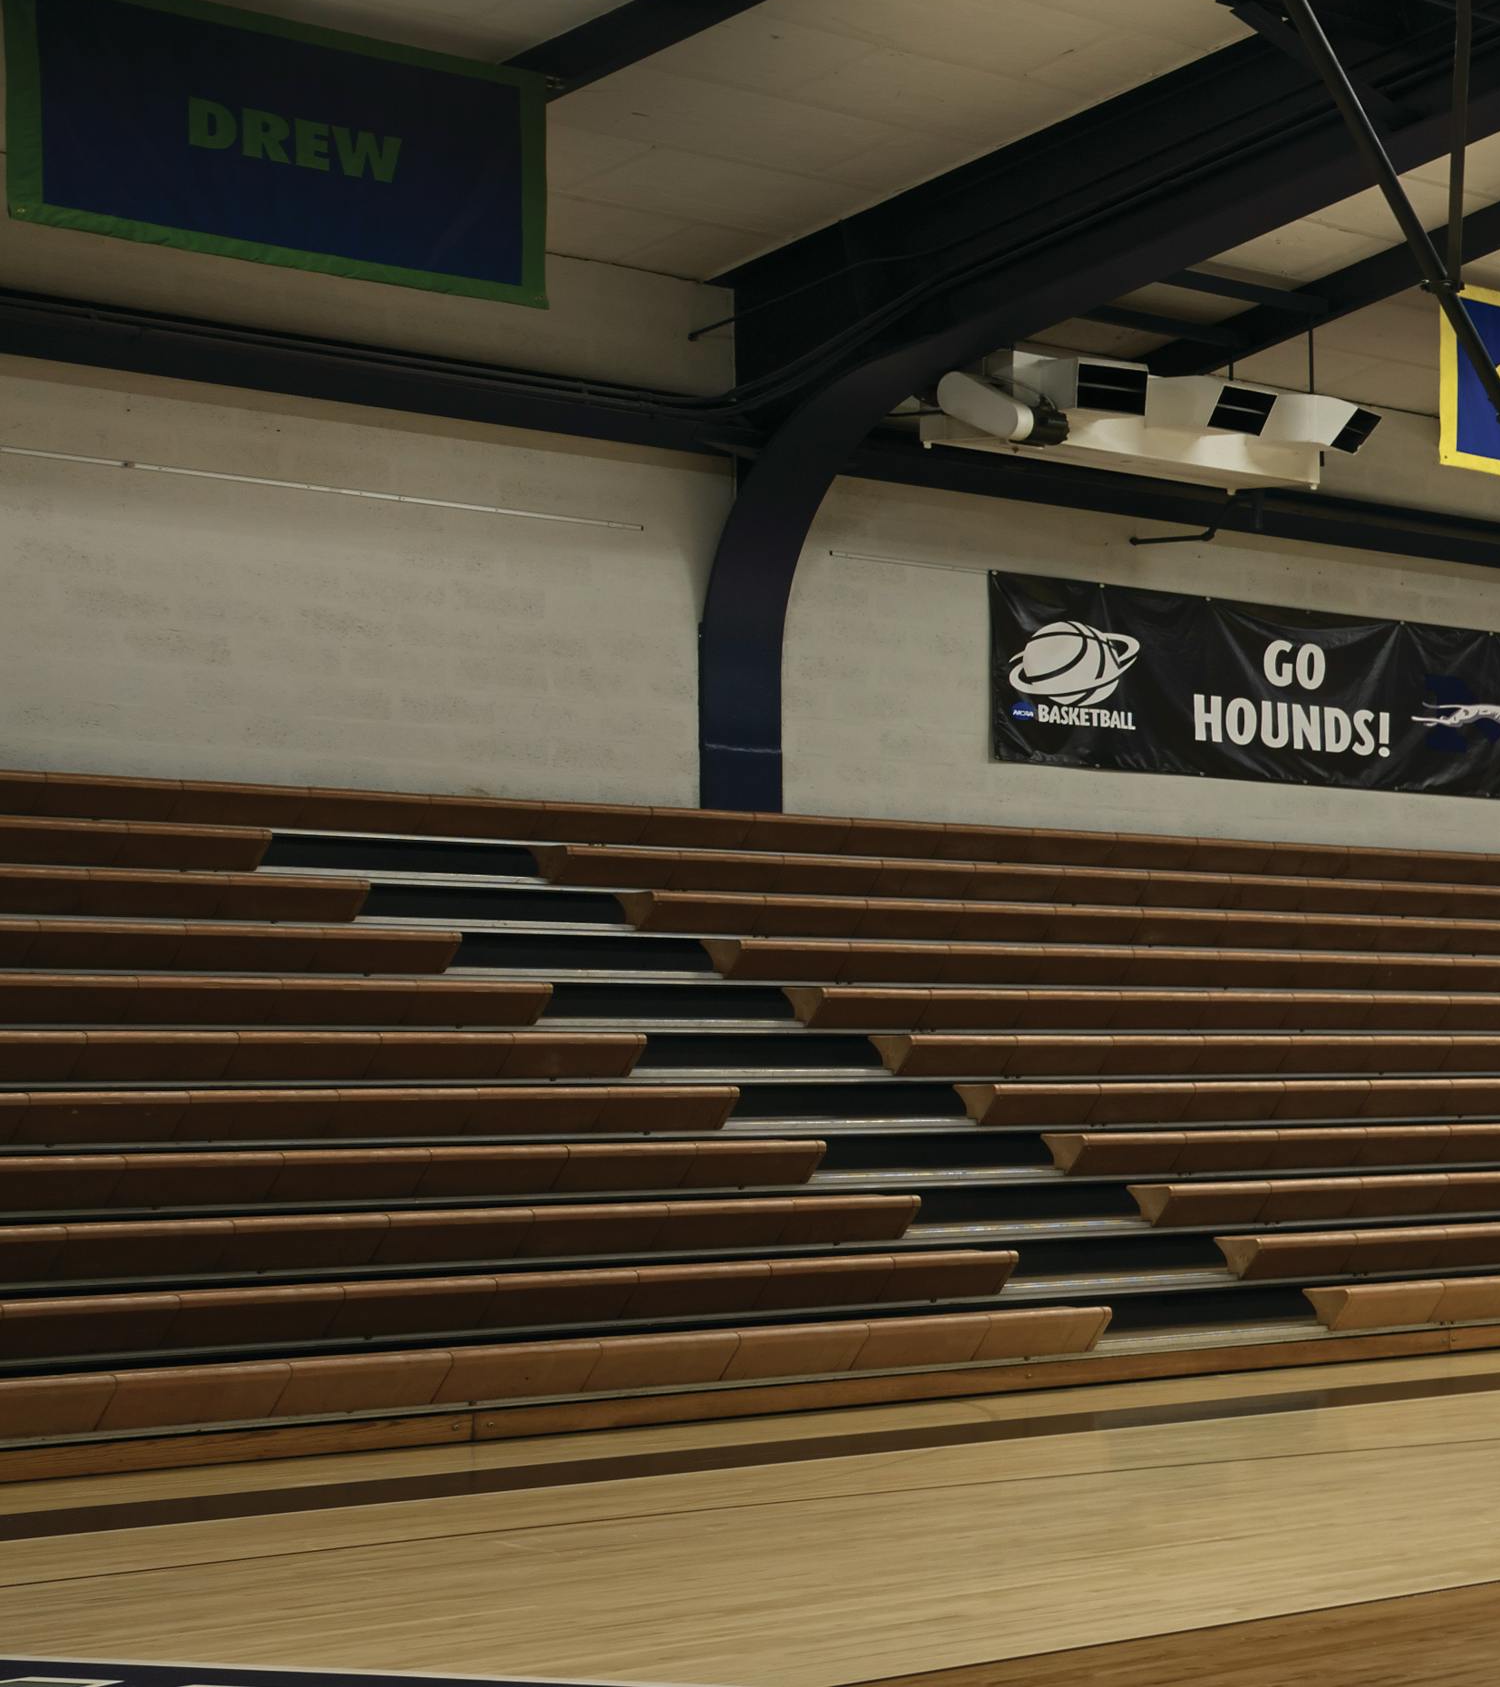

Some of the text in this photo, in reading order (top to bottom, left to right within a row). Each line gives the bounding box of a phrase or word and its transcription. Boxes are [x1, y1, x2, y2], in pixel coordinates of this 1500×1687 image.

[188, 96, 402, 184] DREW
[1262, 640, 1326, 690] GO
[1038, 704, 1136, 730] BASKETBALL
[1193, 694, 1391, 758] HOUNDS!
